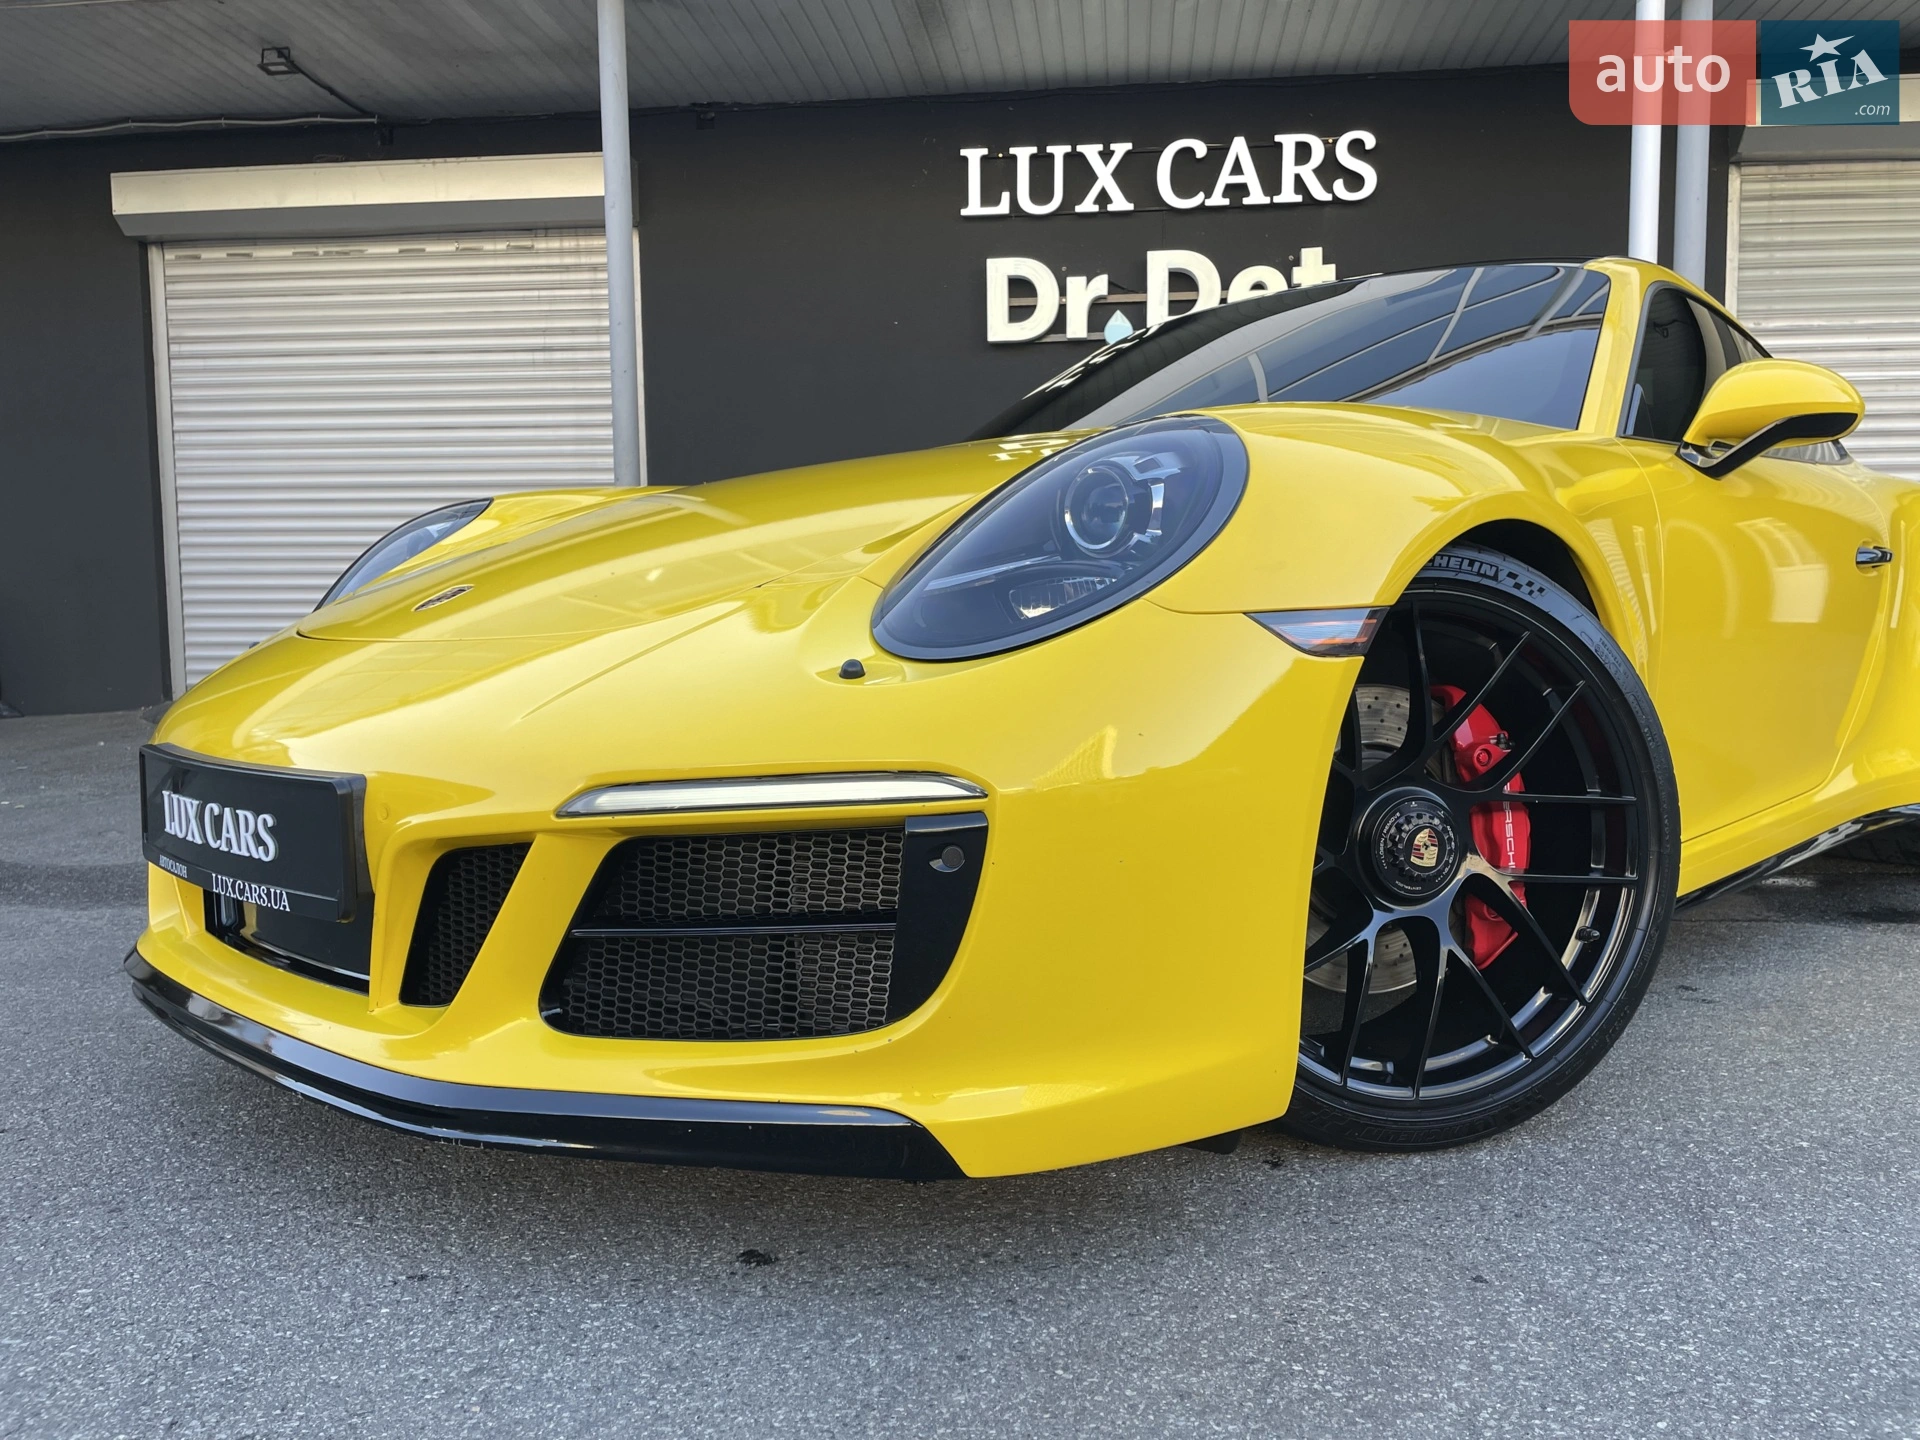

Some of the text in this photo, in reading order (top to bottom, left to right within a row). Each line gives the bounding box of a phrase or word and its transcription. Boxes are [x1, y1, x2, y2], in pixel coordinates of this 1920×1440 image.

[959, 130, 1378, 217] LUX CARS
[162, 790, 279, 862] LUX CARS
